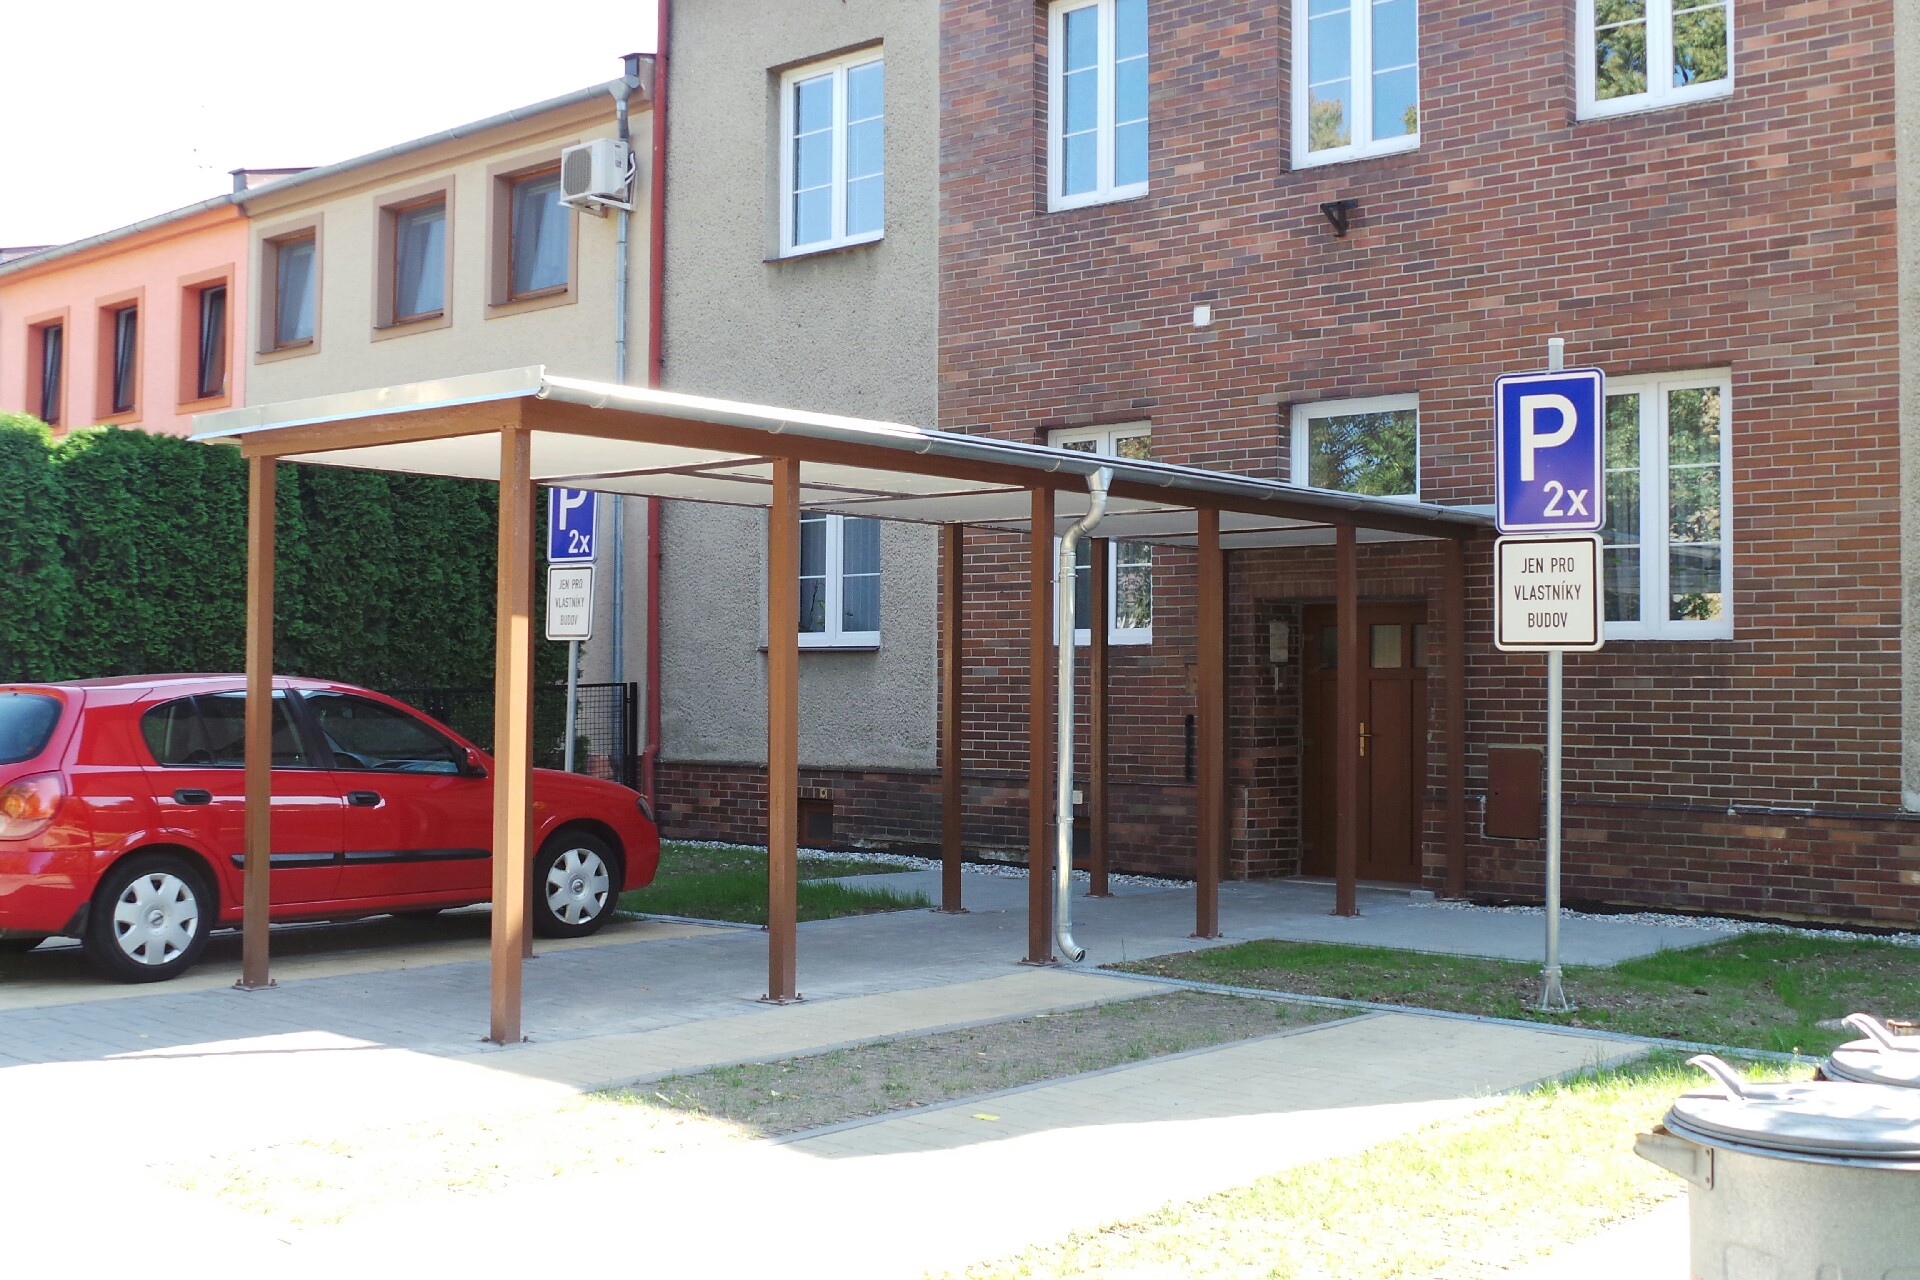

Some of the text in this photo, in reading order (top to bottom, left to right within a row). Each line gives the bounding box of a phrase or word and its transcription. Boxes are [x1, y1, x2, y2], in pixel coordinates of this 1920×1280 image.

[1520, 394, 1577, 481] P
[1543, 480, 1588, 517] 2x
[559, 489, 588, 530] P
[568, 529, 590, 553] 2x
[1521, 556, 1574, 574] JEN PRO
[558, 578, 583, 589] JEN PRO
[1514, 580, 1581, 600] VLASTNÍKY
[555, 596, 585, 608] VLASTNÍKY
[560, 615, 578, 625] BUDOV
[1527, 612, 1567, 628] BUDOV
